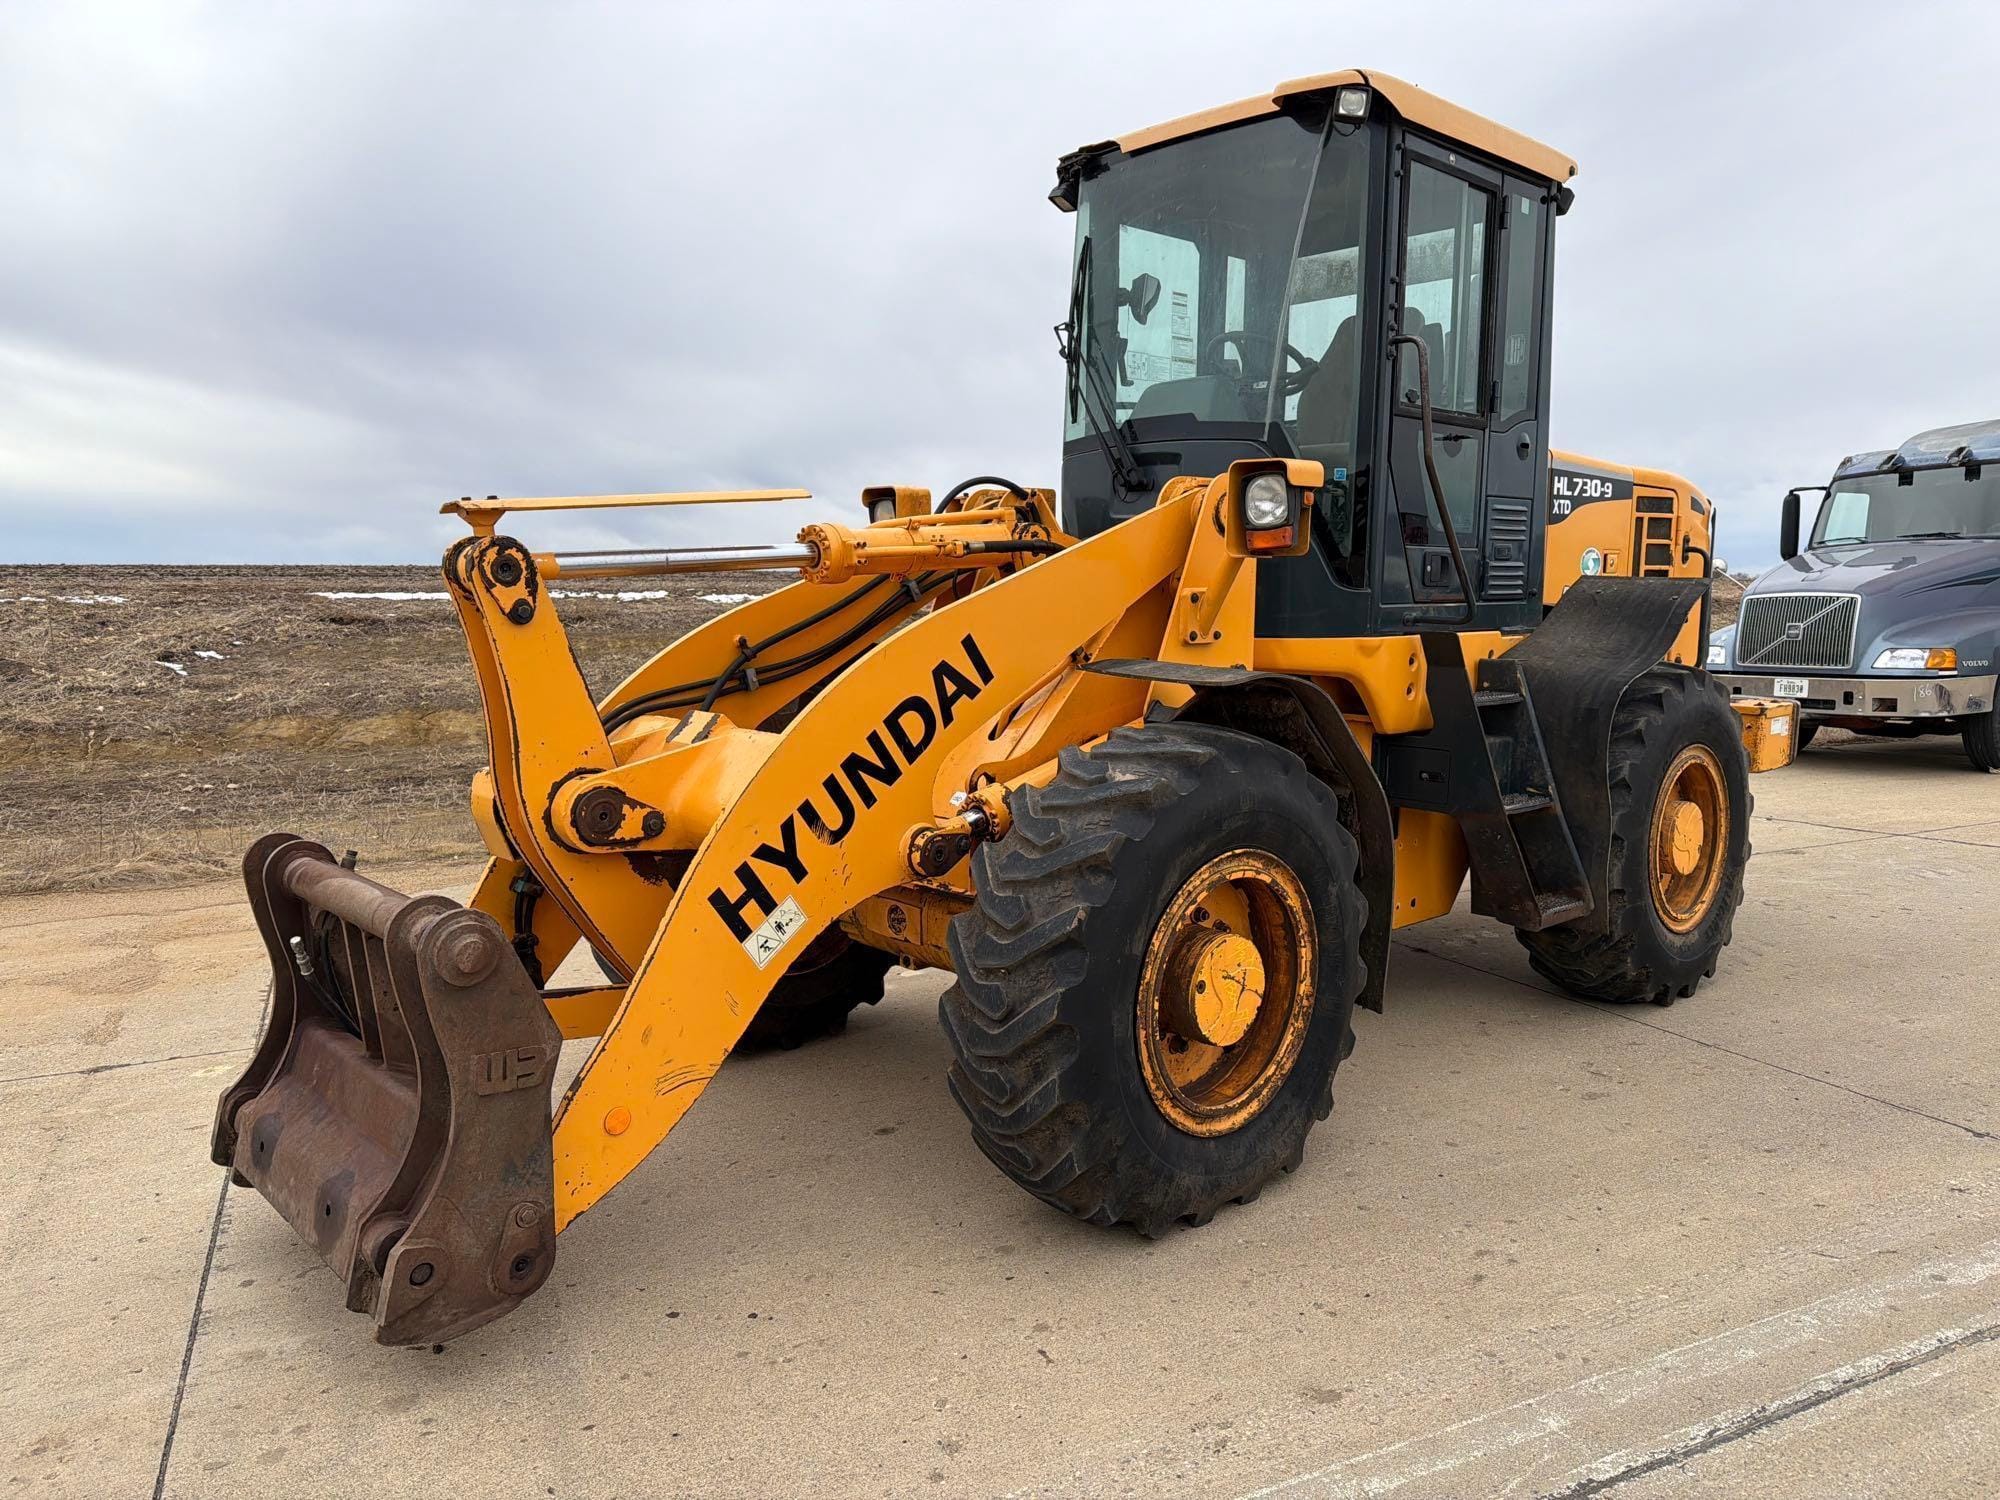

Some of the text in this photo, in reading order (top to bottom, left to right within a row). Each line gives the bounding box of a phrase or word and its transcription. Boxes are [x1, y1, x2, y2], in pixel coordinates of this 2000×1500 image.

[1553, 476, 1612, 497] HL730-9
[1552, 499, 1572, 514] XTD
[707, 632, 995, 944] HYUNDAI
